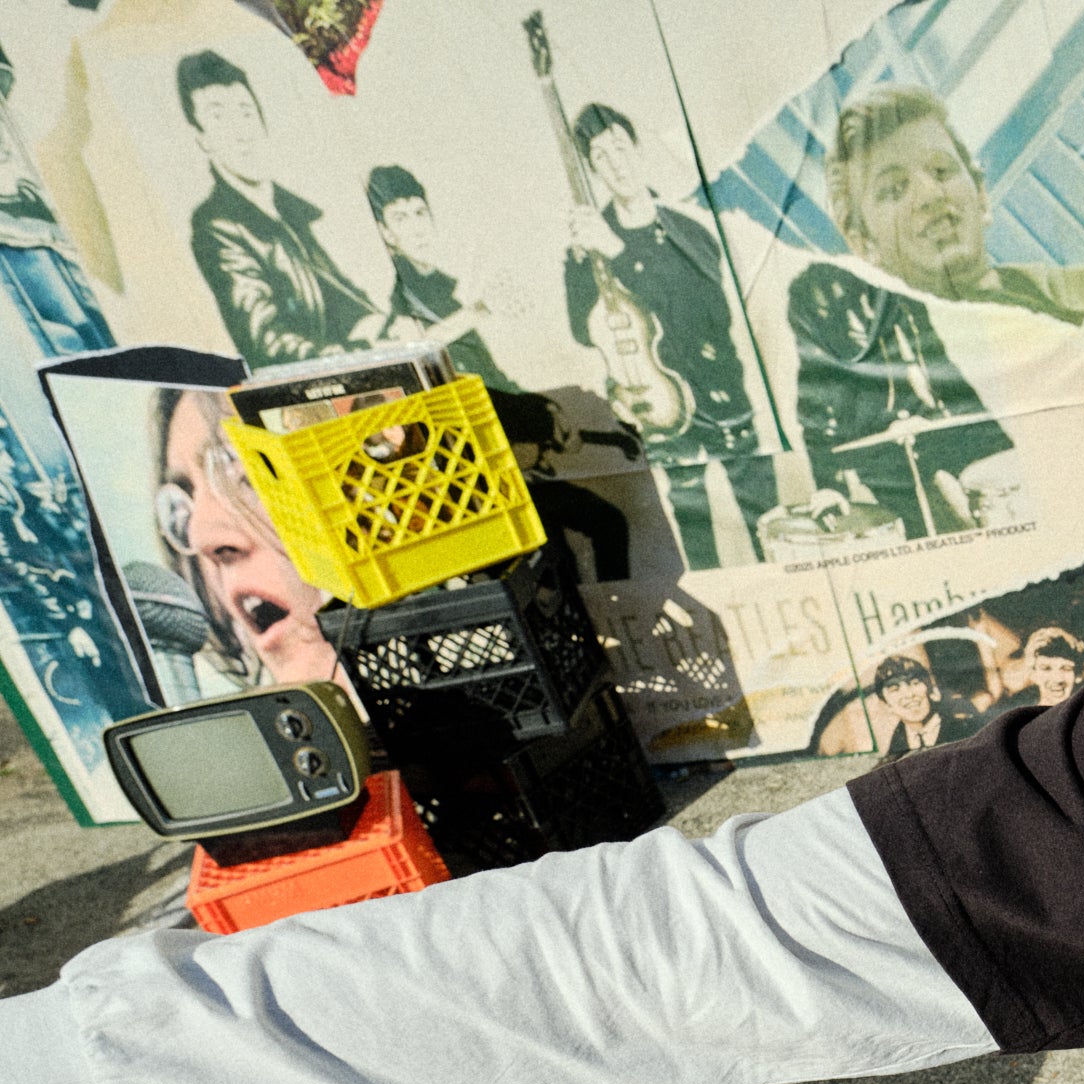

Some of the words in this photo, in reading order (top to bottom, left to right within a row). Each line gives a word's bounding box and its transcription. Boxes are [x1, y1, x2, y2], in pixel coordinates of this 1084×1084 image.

[817, 556, 850, 569] APPLE
[852, 549, 888, 563] CORPS
[915, 543, 924, 552] A
[985, 521, 1037, 539] PRODUCT
